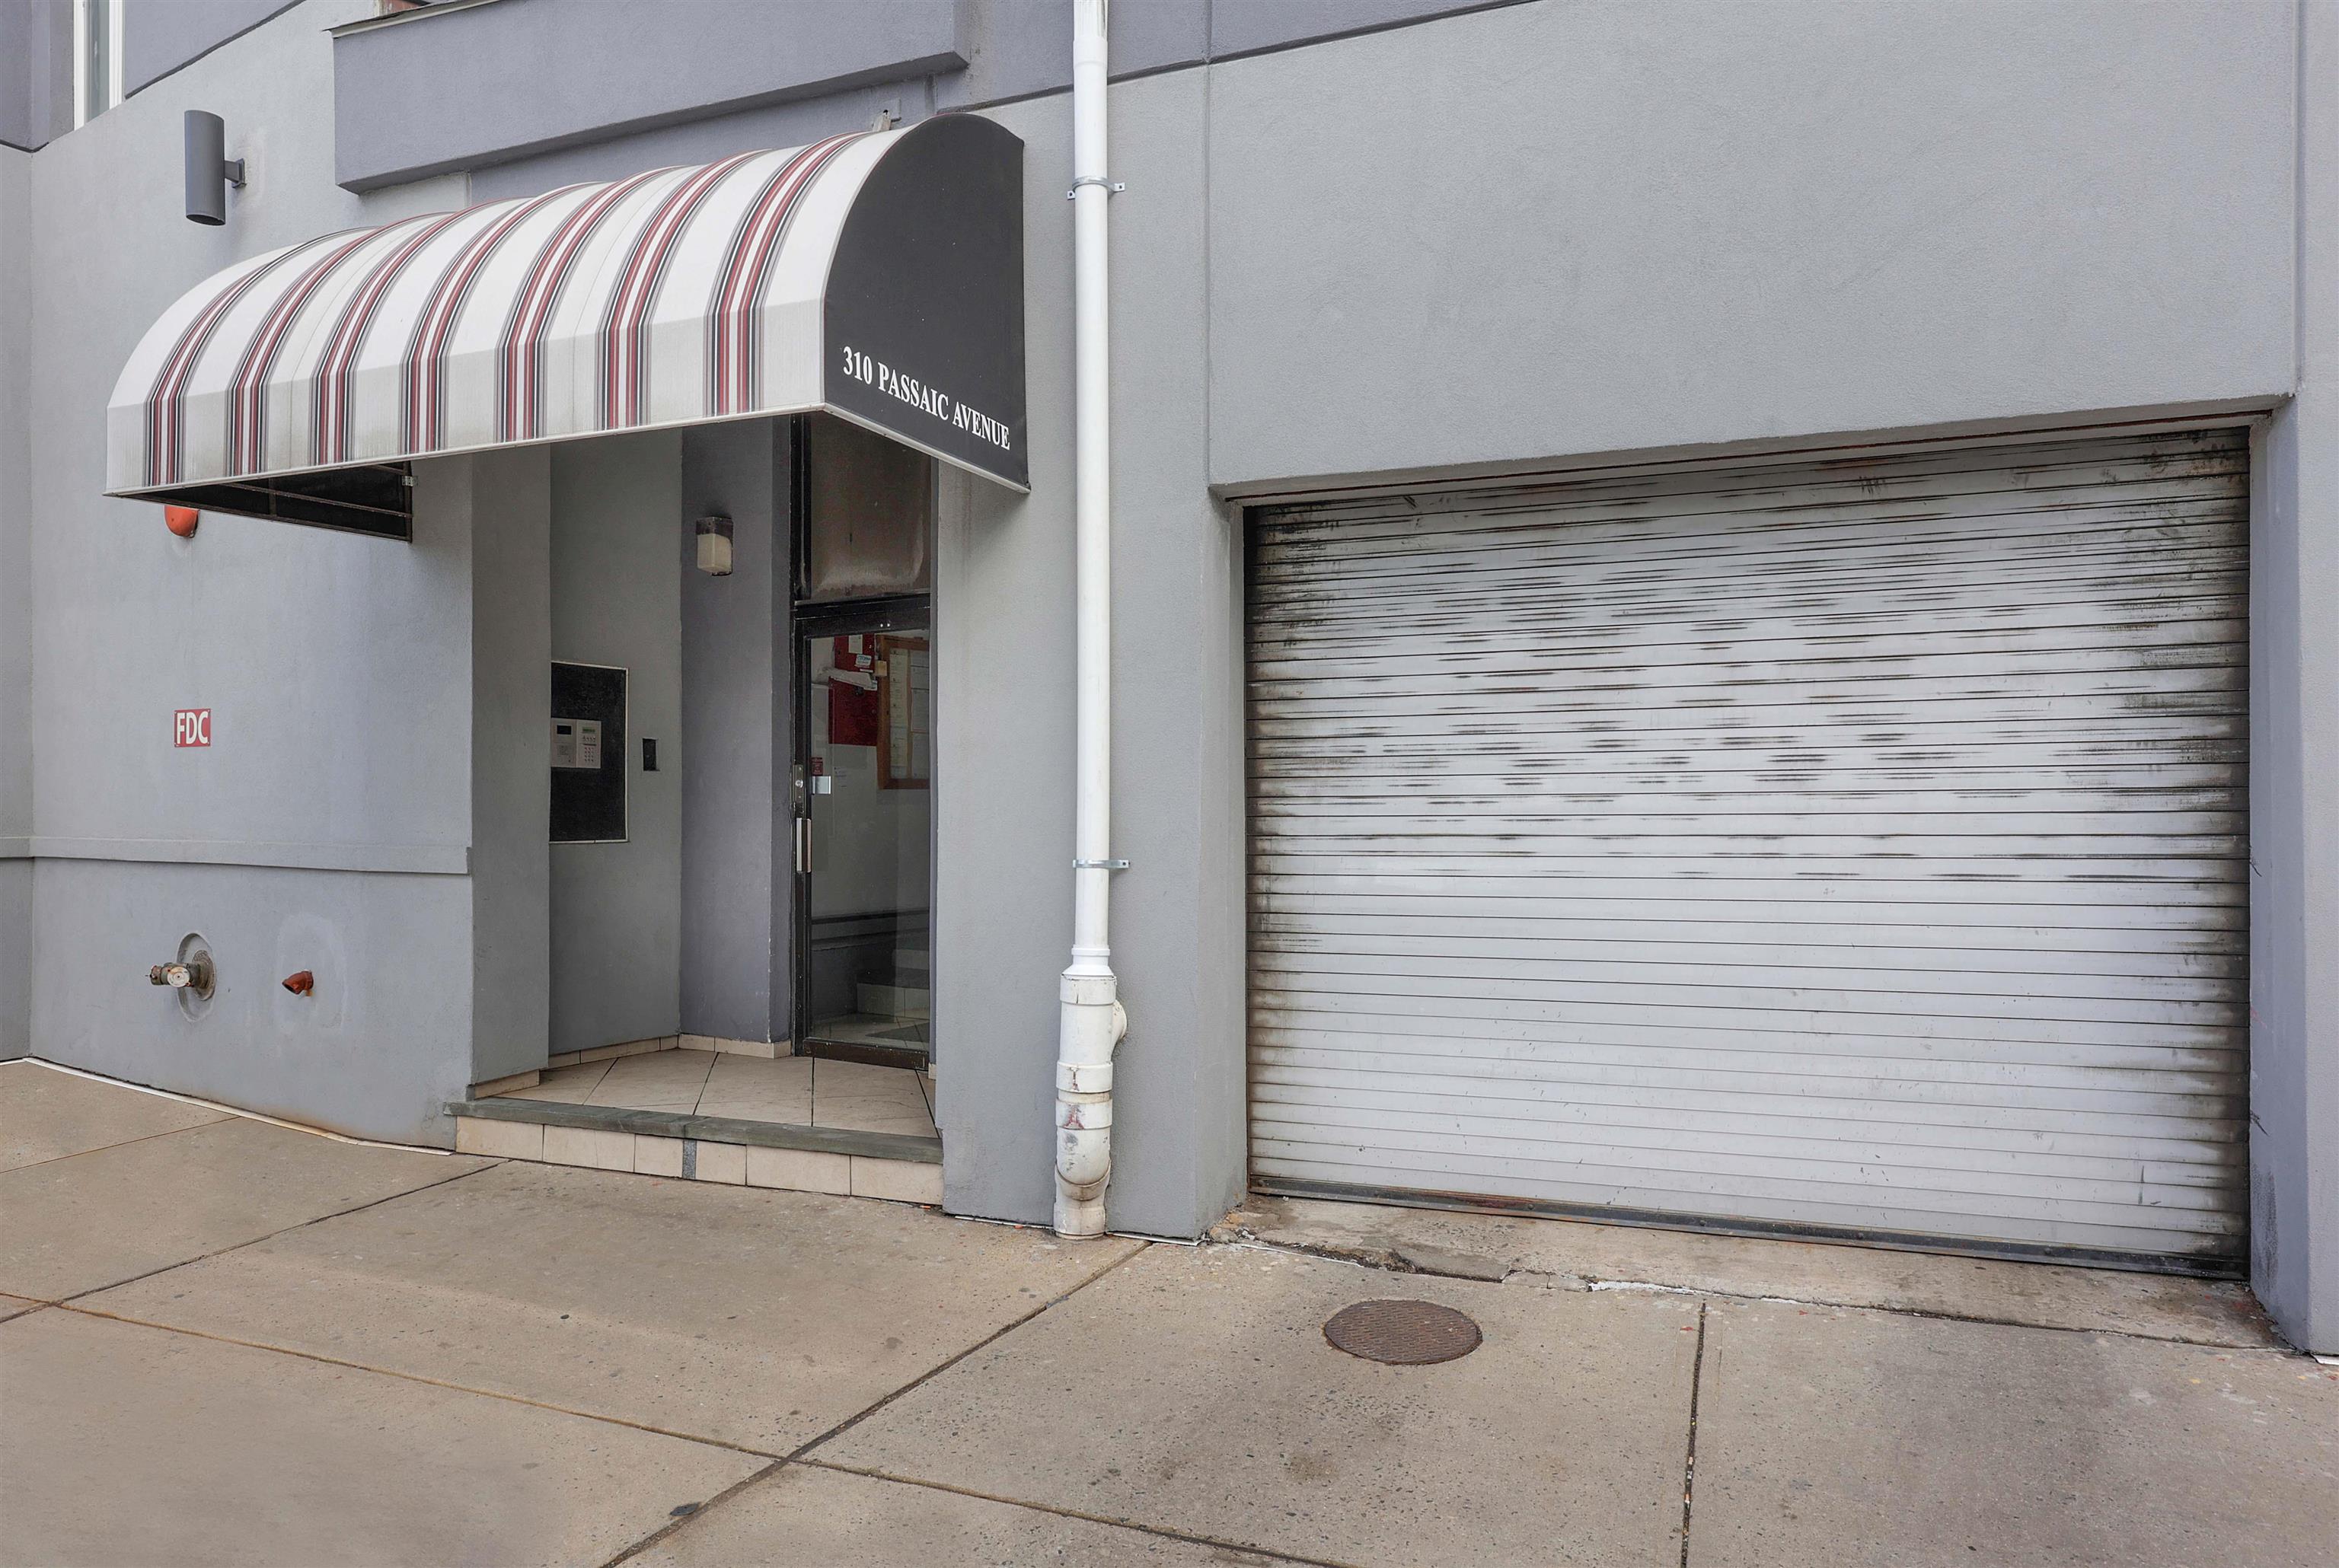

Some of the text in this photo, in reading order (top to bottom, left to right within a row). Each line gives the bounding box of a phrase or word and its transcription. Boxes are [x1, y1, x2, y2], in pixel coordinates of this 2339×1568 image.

[843, 346, 1010, 451] 310 PASSAIC AVENUE
[177, 711, 209, 744] FDC
